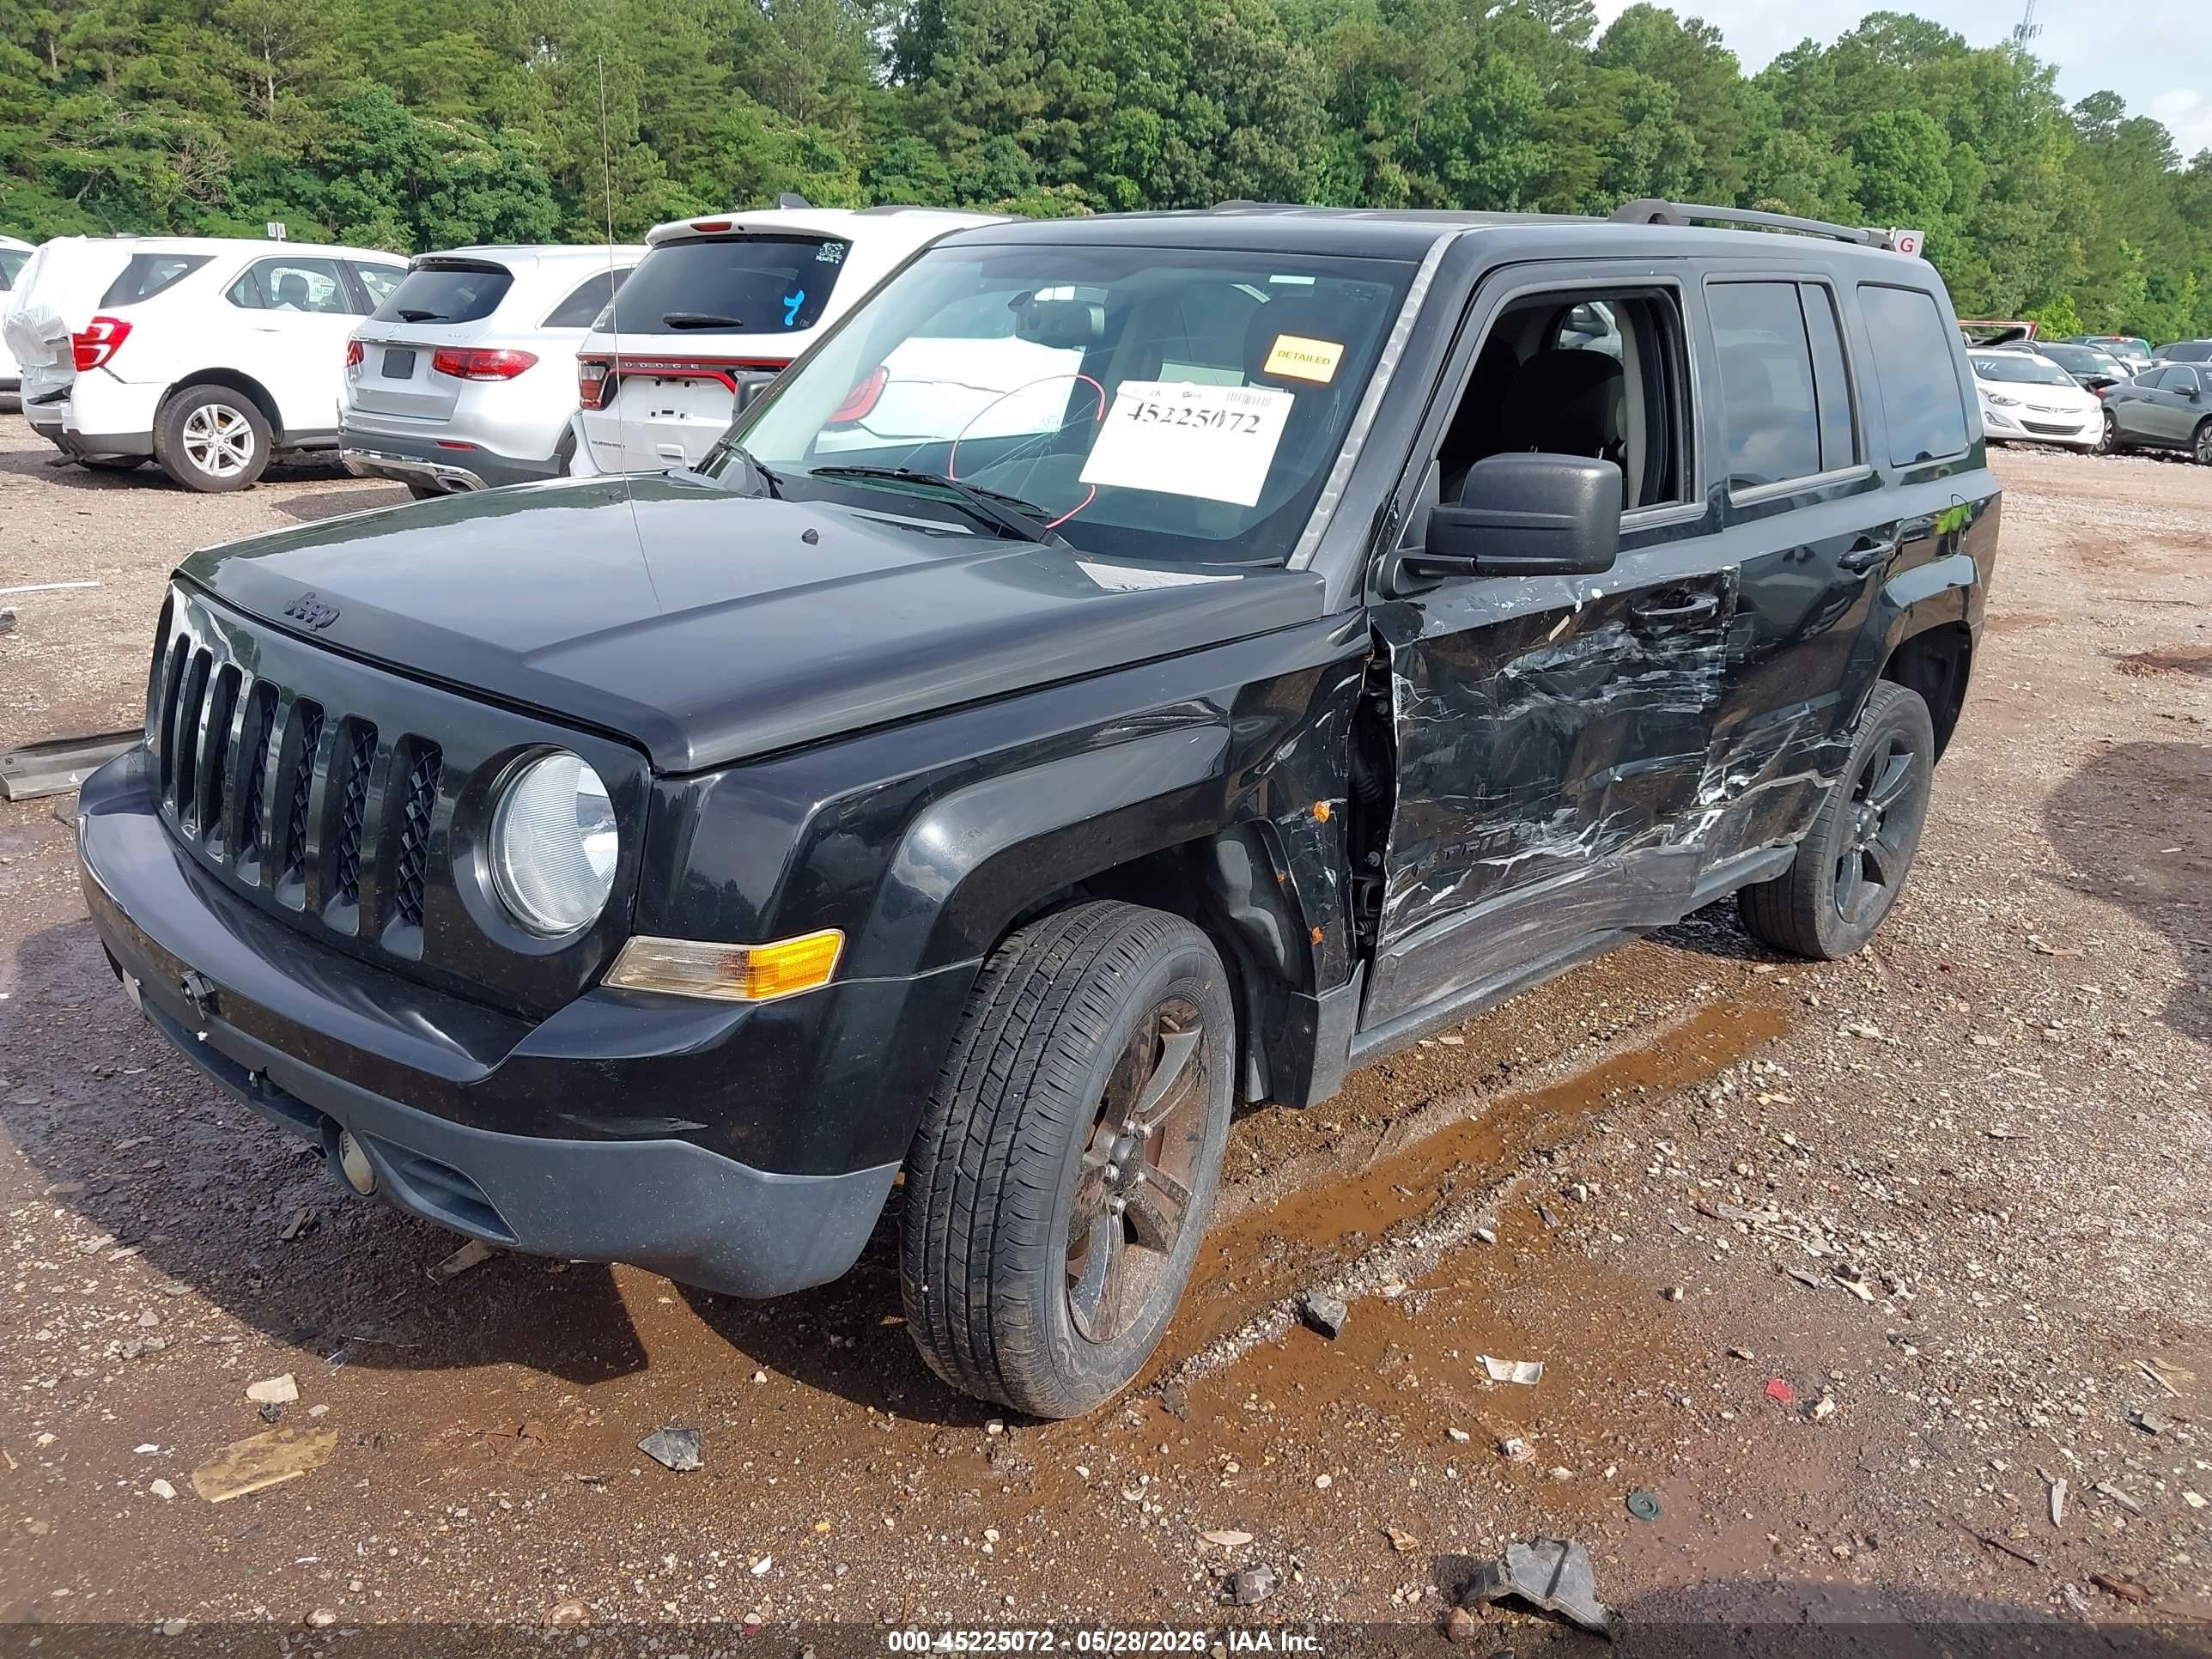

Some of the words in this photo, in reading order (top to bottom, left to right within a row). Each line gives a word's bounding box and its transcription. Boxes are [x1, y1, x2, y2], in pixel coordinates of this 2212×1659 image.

[1899, 237, 1915, 253] G
[1277, 349, 1331, 365] DETAILED
[624, 362, 701, 370] DODGE
[1127, 401, 1261, 434] 45225072
[283, 591, 341, 633] Jeep
